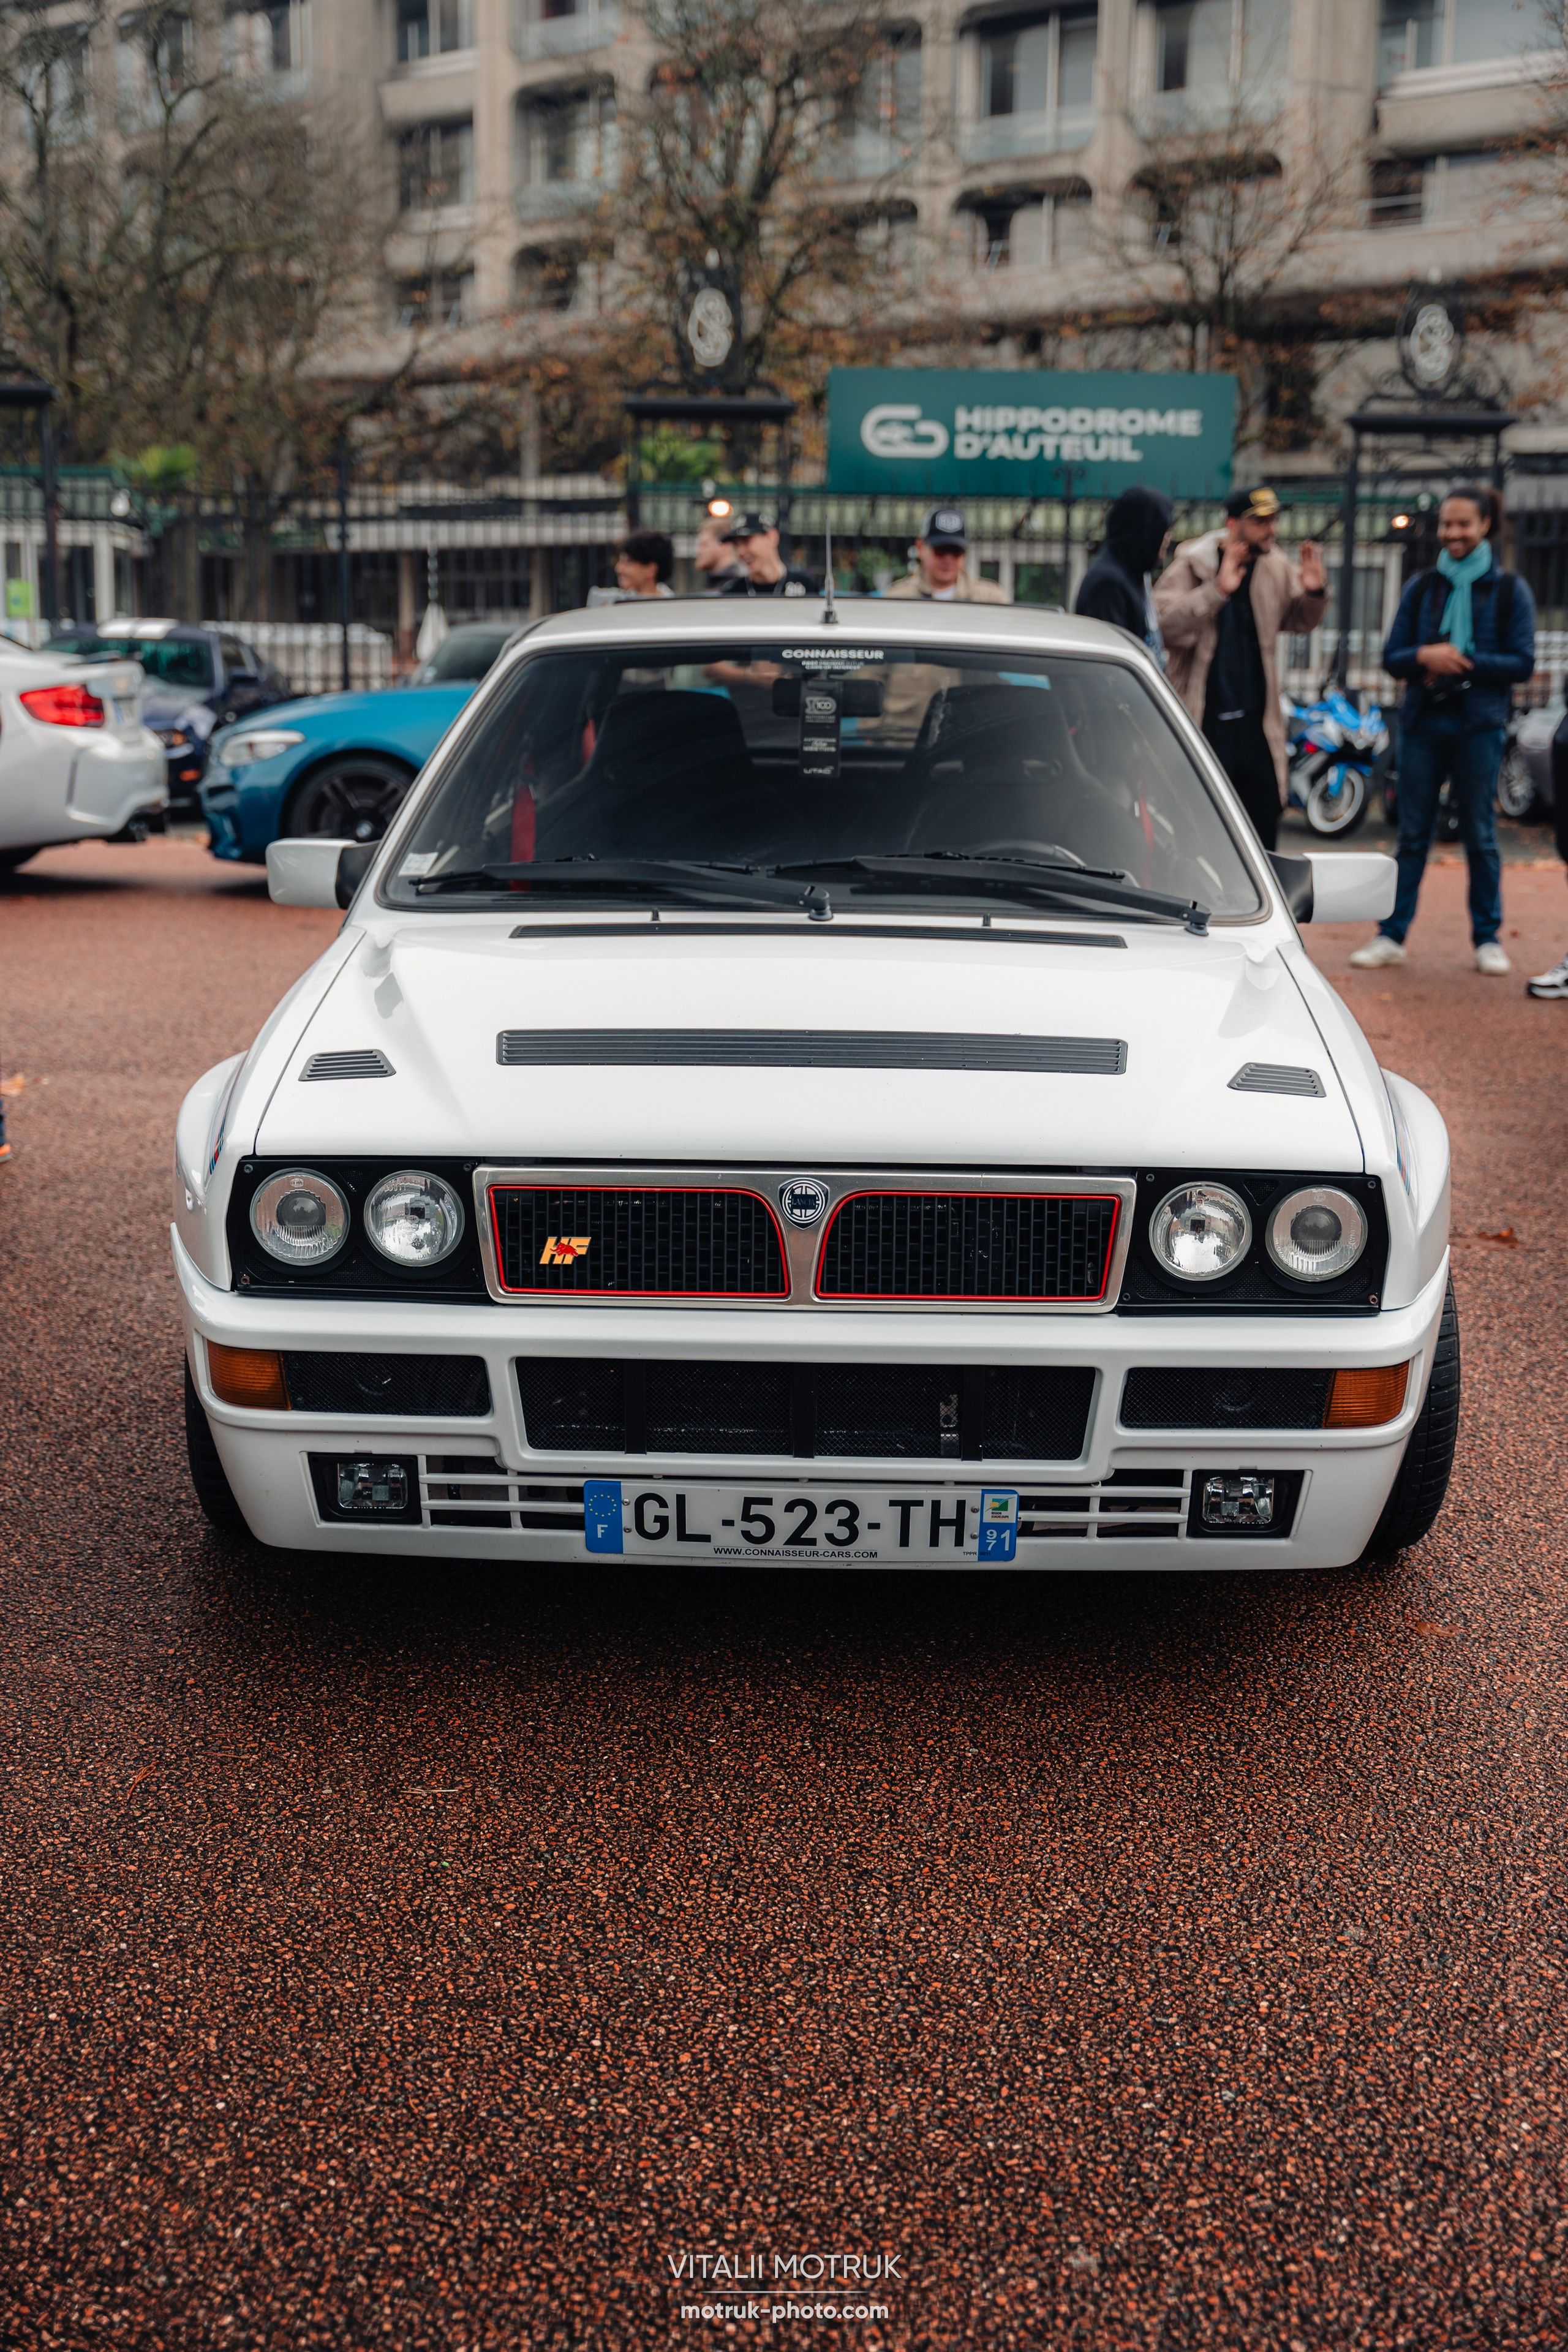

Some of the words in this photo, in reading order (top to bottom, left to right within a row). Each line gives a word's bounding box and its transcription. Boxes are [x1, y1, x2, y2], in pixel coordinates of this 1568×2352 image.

[954, 405, 1203, 436] HIPPODROME
[954, 432, 1144, 461] D'AUTEUIL
[782, 649, 884, 659] CONNAISSEUR
[539, 1237, 592, 1264] HF
[597, 1524, 608, 1539] F
[634, 1492, 967, 1548] GL-523-TH
[713, 1547, 878, 1559] WWW.CONNAISSEUR-CARS.COM
